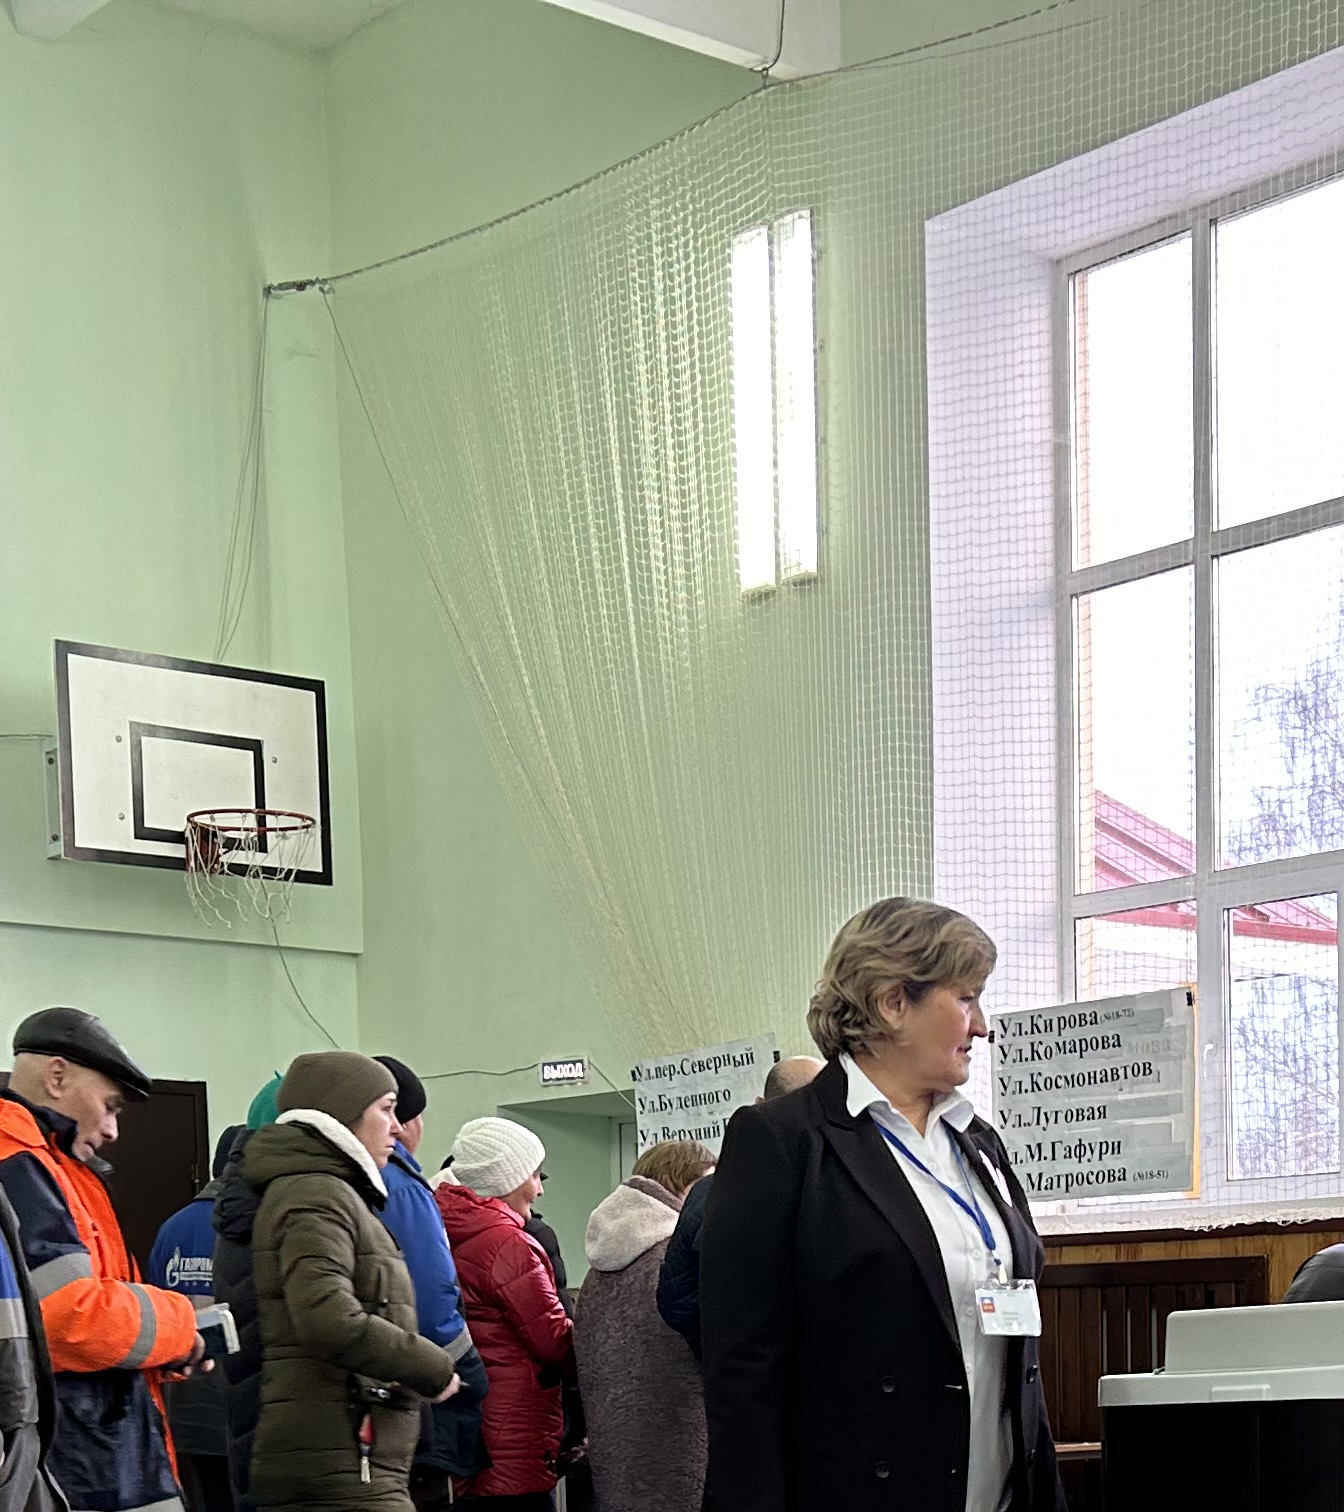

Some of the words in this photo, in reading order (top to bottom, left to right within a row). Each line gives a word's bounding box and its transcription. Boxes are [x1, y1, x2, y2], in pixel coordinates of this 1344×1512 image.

[998, 1010, 1098, 1038] Ул.Кирова
[998, 1033, 1122, 1065] Ул.Комарова
[543, 1062, 584, 1080] ВЫХОД
[998, 1060, 1153, 1097] Ул.Космонавтов
[999, 1104, 1108, 1132] Ул.Луговая
[639, 1121, 721, 1147] УлВерхний
[1006, 1138, 1122, 1166] л.М.Гафури
